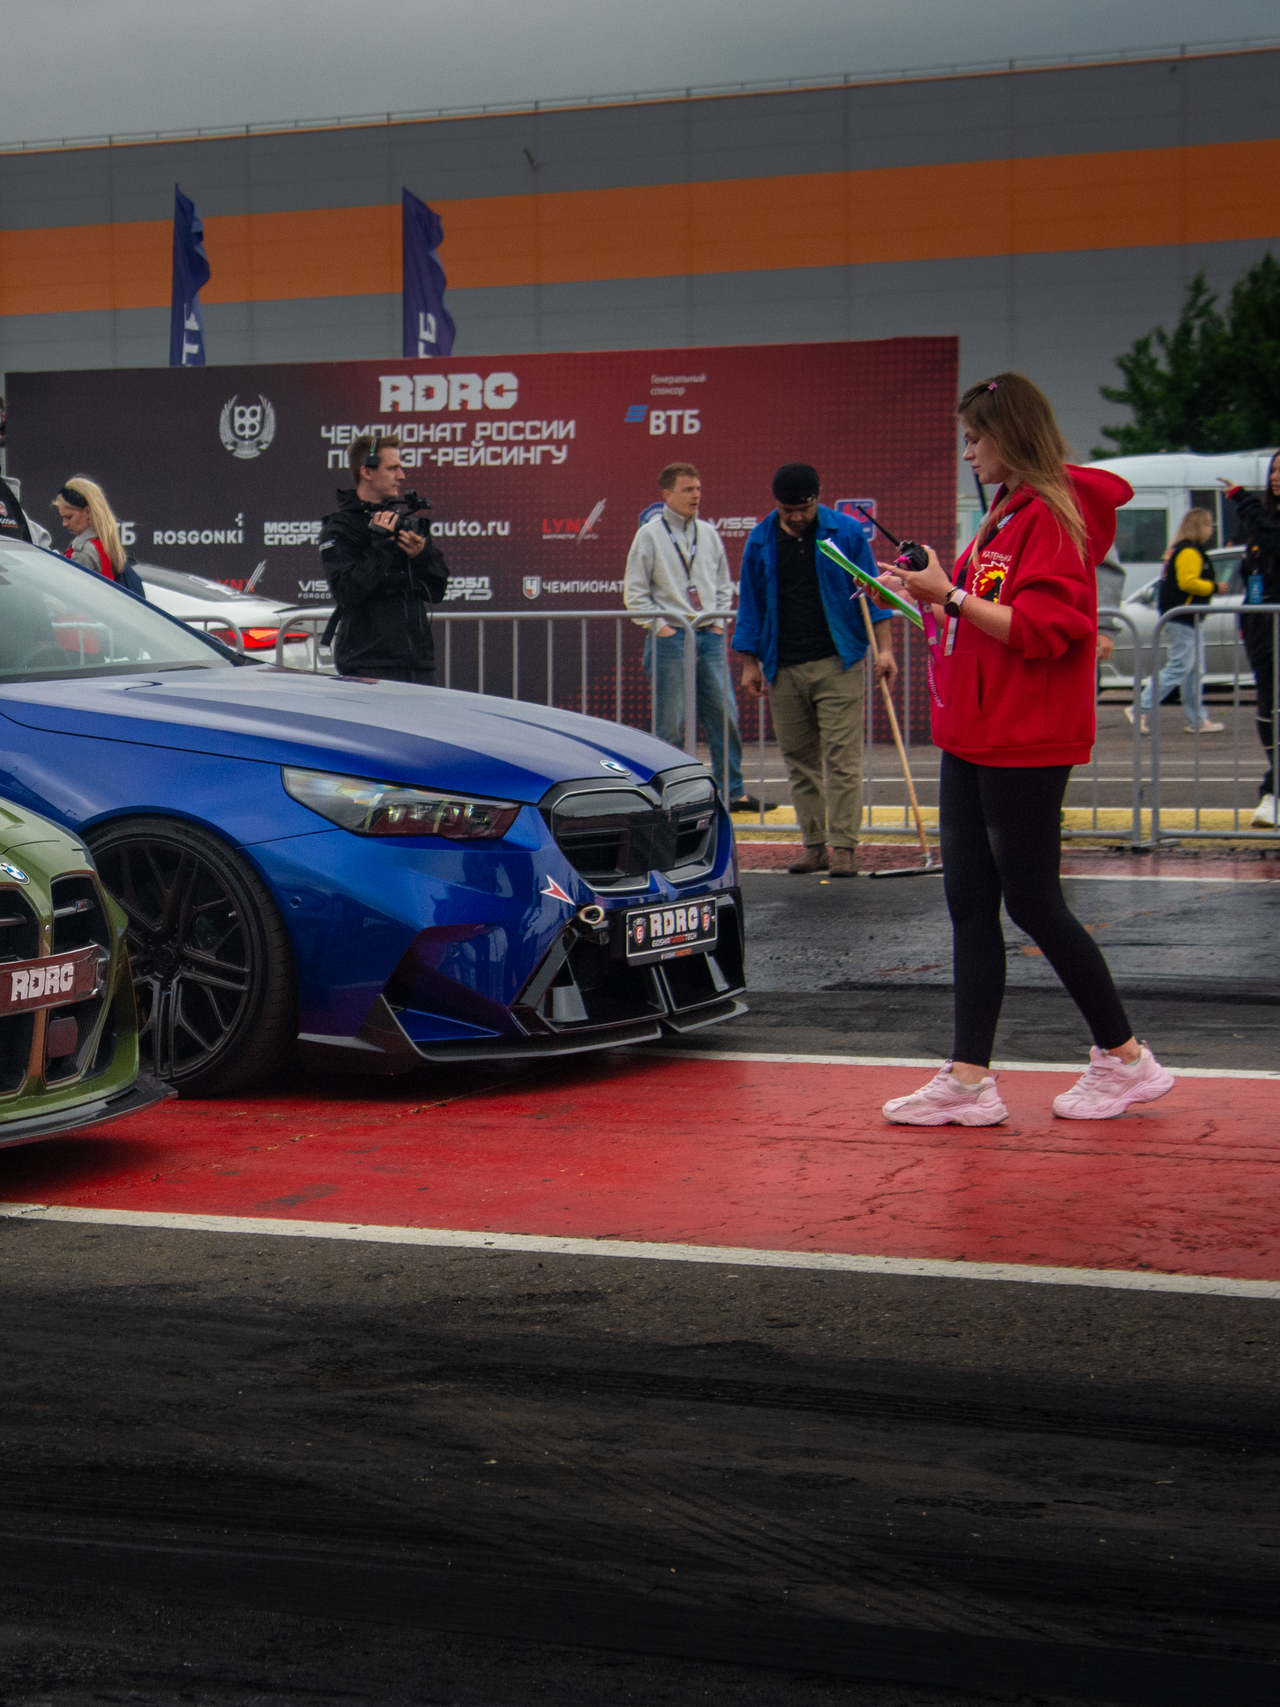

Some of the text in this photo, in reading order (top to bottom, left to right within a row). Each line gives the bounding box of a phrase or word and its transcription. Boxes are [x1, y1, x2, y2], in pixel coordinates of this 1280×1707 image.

[378, 372, 518, 412] RDRC
[475, 419, 576, 442] РОССИИ
[649, 408, 702, 436] ВТБ
[399, 440, 568, 468] ЭГ-РЕЙСИНГУ
[152, 530, 245, 545] ROSGONKI
[429, 519, 510, 537] auto.ru
[650, 906, 699, 937] RDRC
[11, 962, 74, 1002] RDRC
